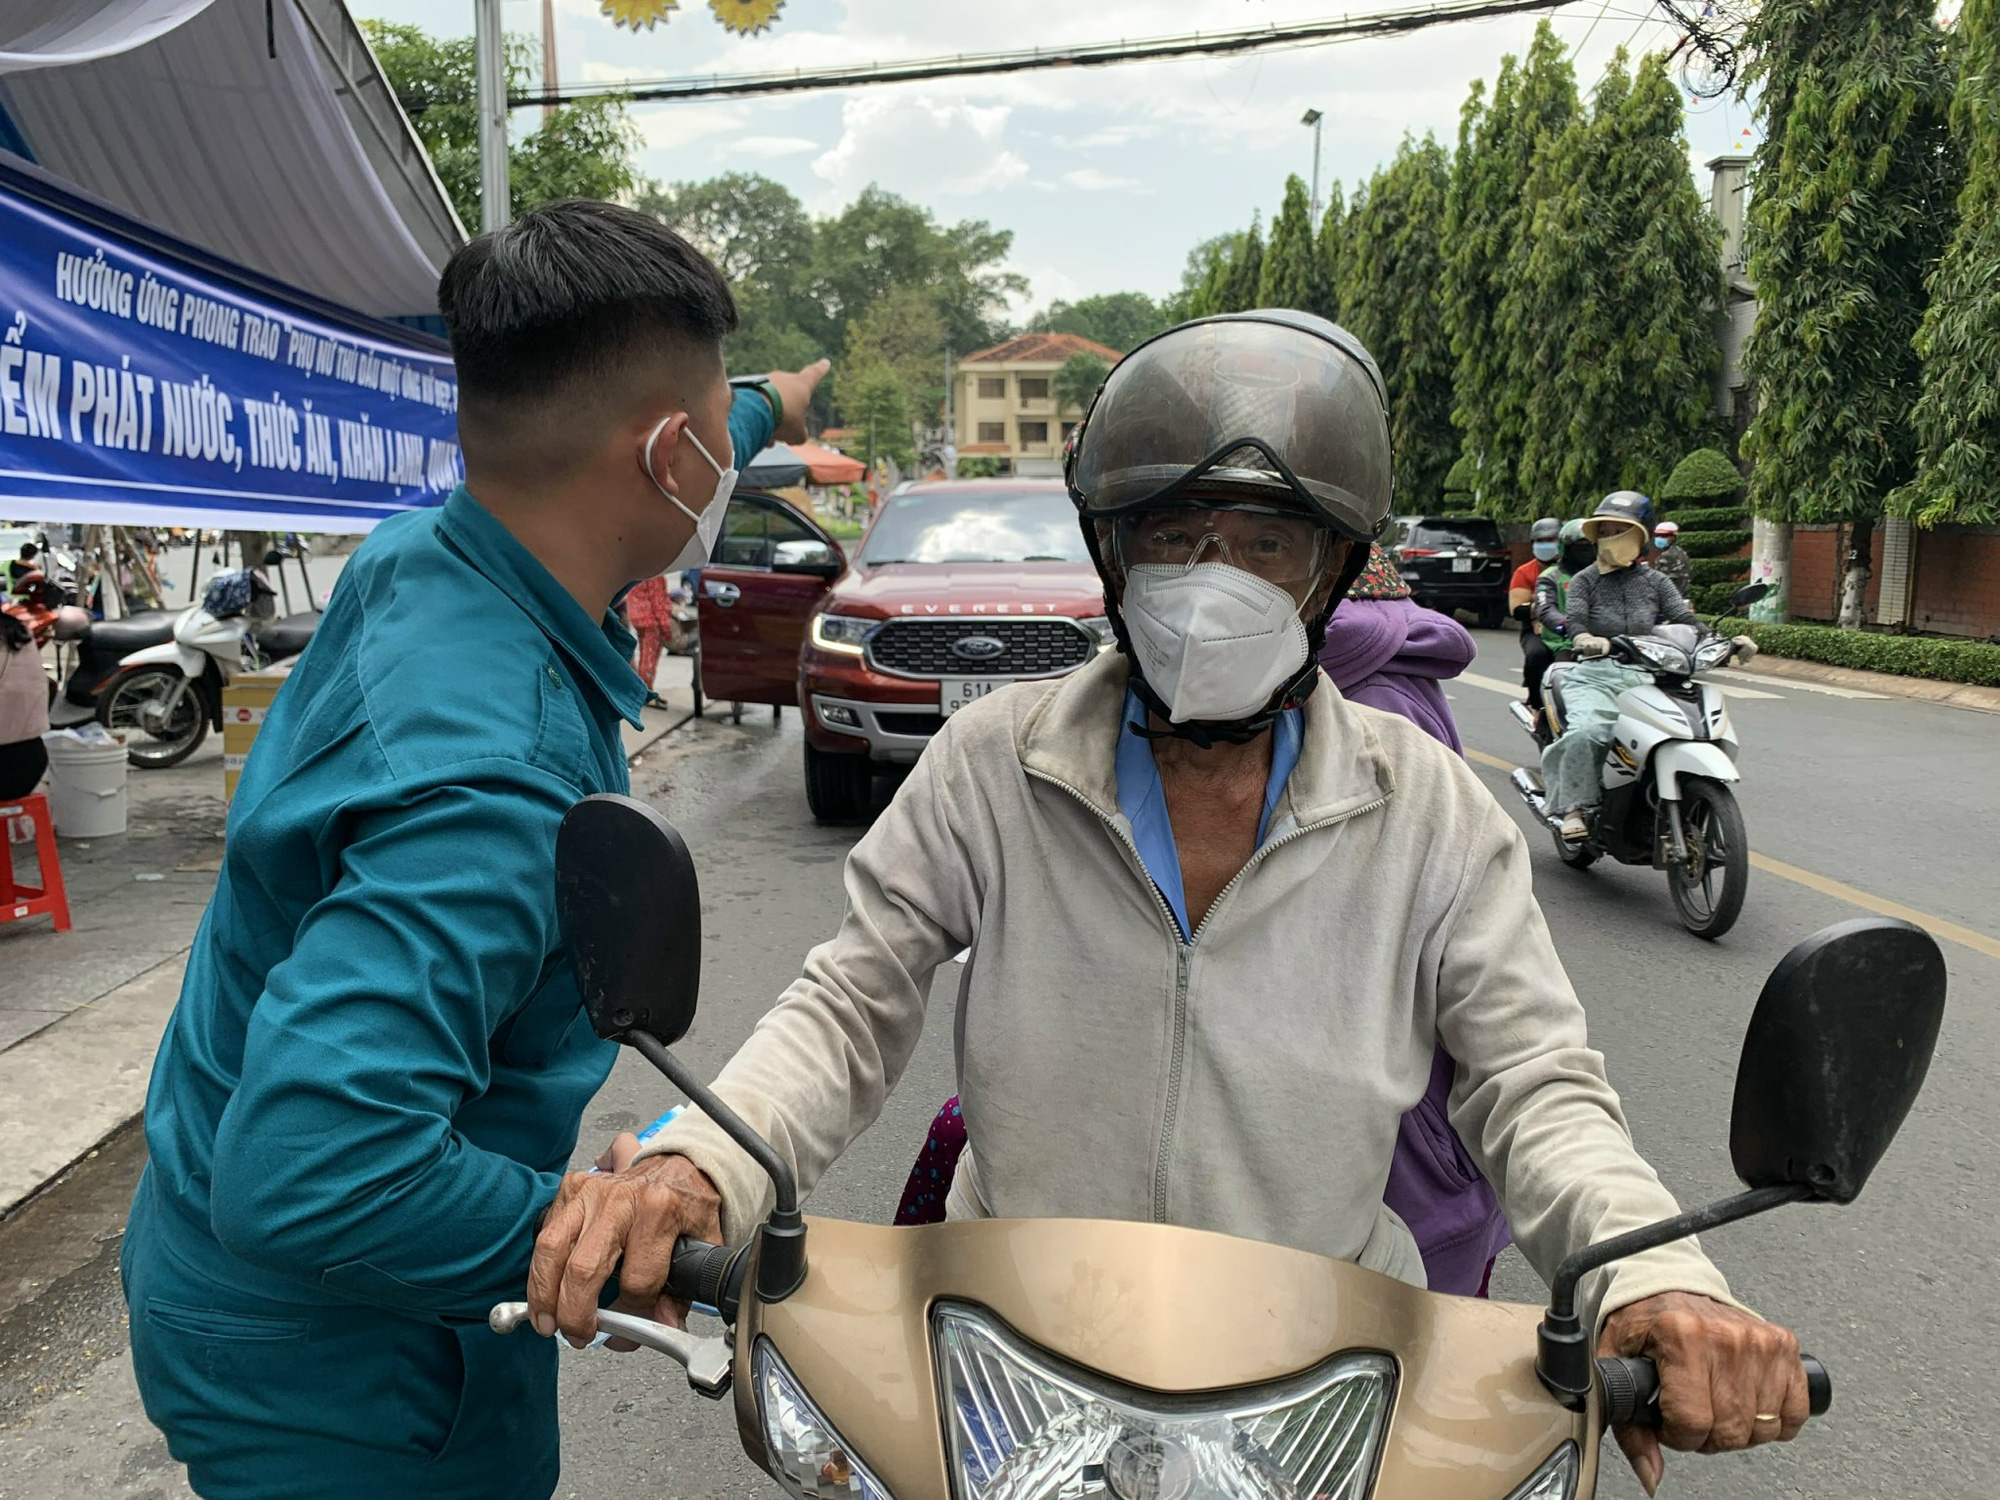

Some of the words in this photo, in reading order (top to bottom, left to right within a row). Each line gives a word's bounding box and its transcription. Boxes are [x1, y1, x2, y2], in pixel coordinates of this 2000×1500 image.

[56, 248, 134, 319] HƯỞNG
[136, 270, 180, 332] ỨNG
[180, 292, 240, 350] PHONG
[242, 313, 280, 361] TRÀO
[0, 310, 62, 440] ỂM
[70, 354, 154, 453] PHÁT
[160, 374, 242, 474] NƯỚC,
[244, 391, 301, 472] THỨC
[303, 398, 338, 484] ĂN,
[338, 412, 385, 482] KHĂN
[901, 604, 1057, 614] EVEREST
[962, 682, 993, 698] 61A
